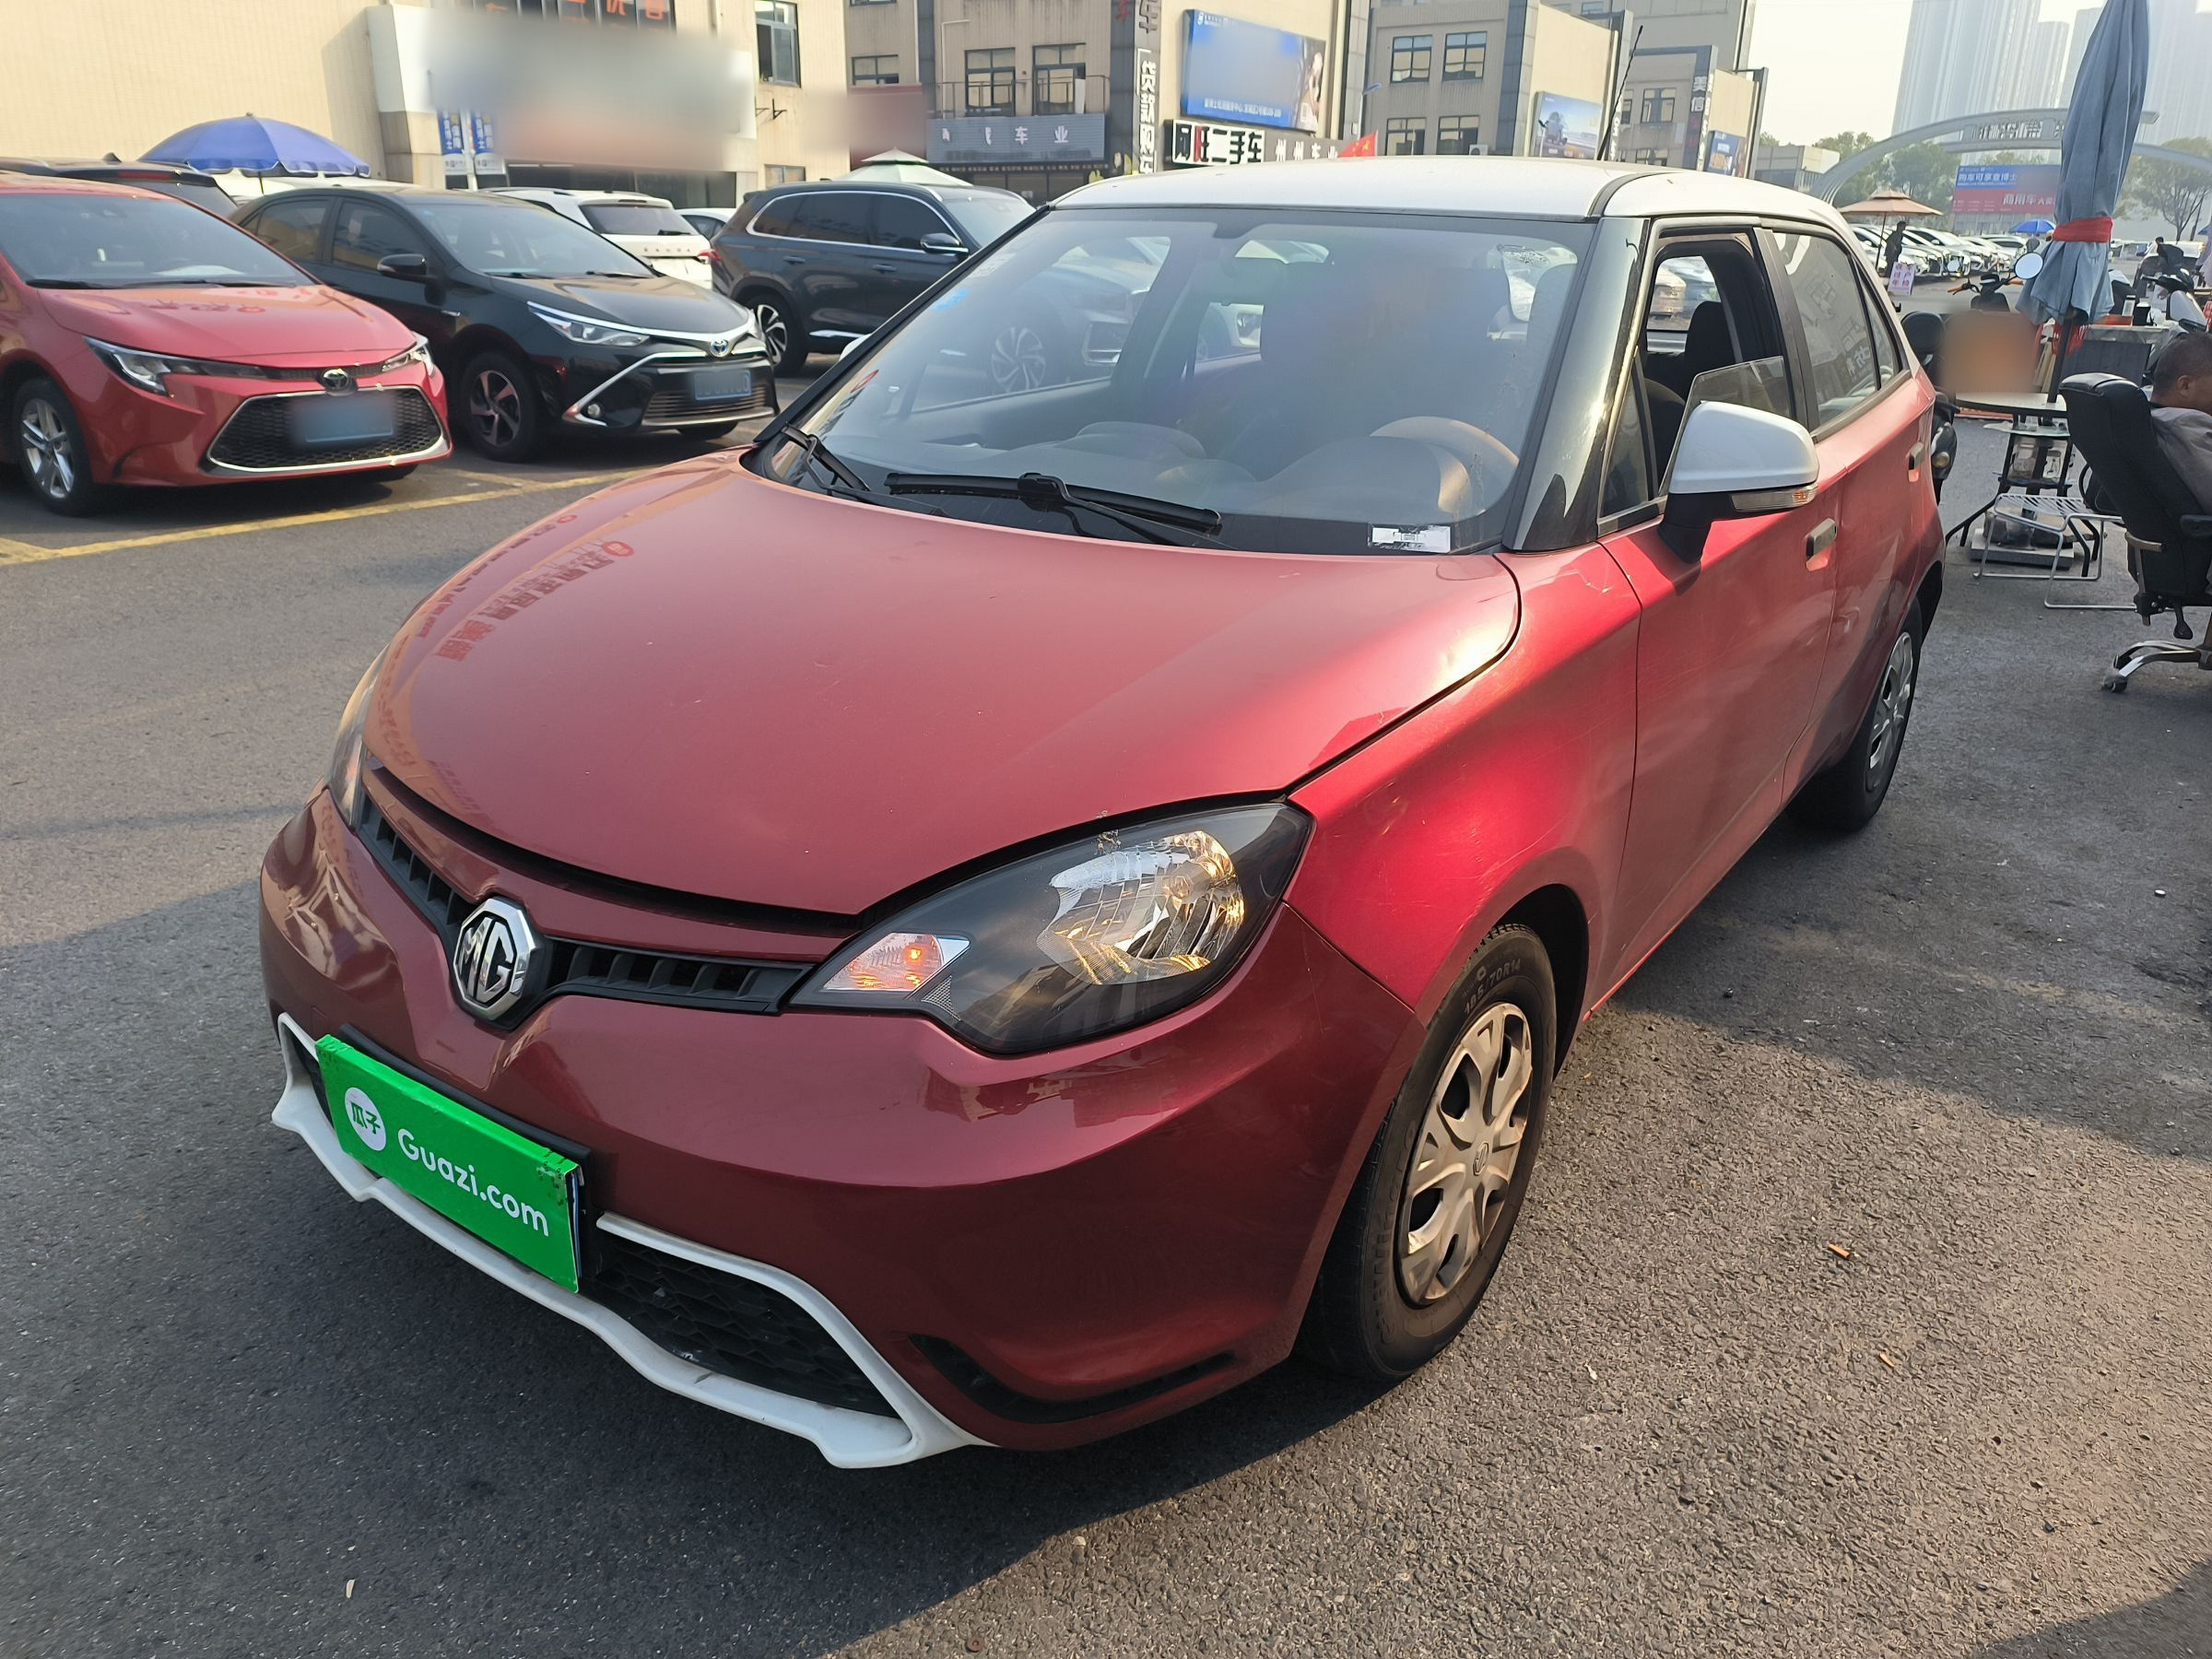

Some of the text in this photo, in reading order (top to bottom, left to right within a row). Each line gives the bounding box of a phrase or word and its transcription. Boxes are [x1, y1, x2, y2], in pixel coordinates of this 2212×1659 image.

[460, 916, 515, 1003] MG
[350, 1103, 381, 1135] 瓜子
[397, 1128, 550, 1237] Guazi.com
